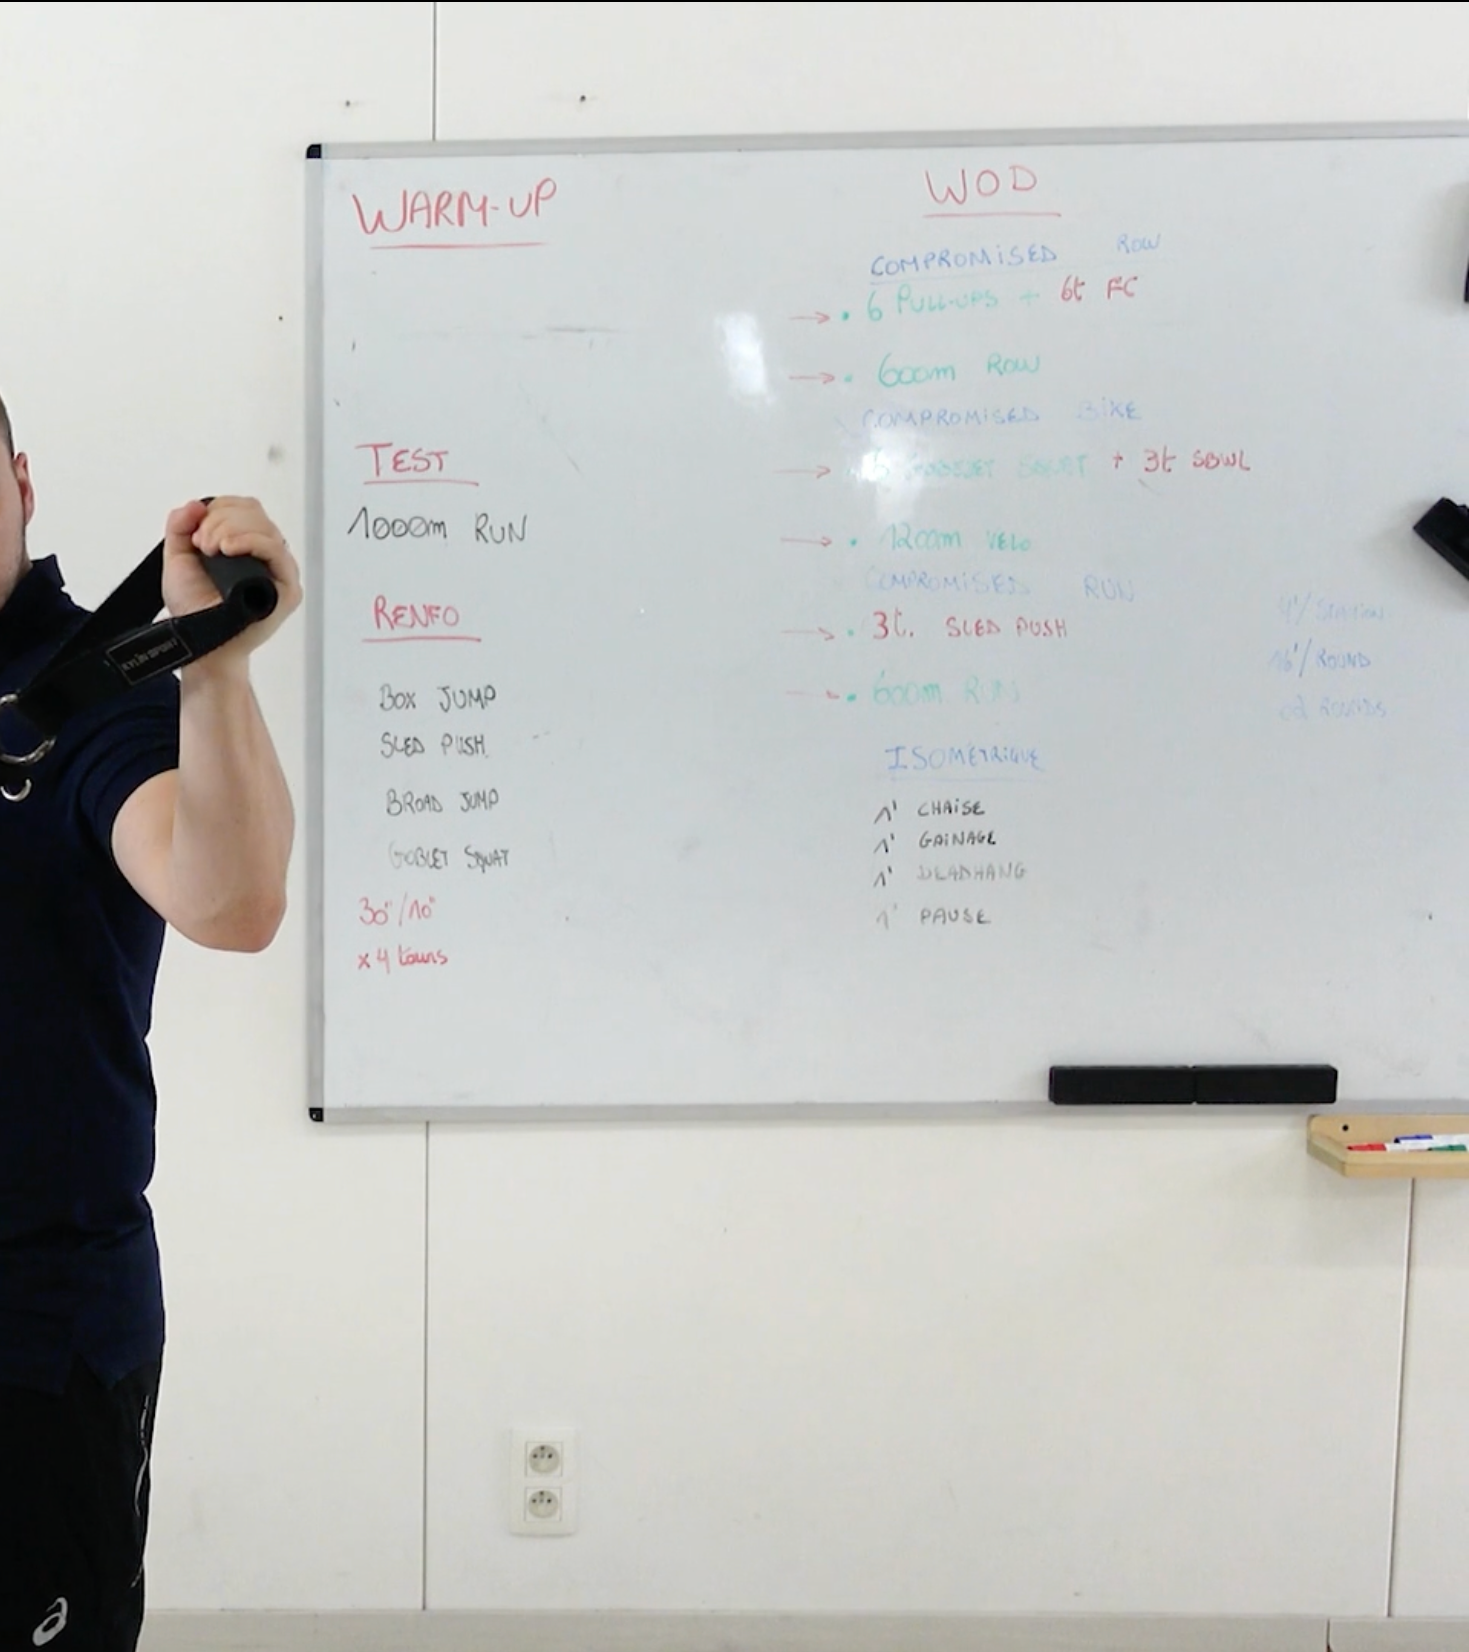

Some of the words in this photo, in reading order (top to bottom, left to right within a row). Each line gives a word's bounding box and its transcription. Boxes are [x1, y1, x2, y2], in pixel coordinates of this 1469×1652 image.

[926, 165, 1038, 205] WOD
[353, 178, 557, 235] WARM-UP
[1116, 233, 1162, 254] ROW
[867, 291, 883, 322] 6
[896, 284, 999, 315] PULL-UPS
[878, 352, 956, 388] 600m
[987, 353, 1041, 375] ROW
[354, 442, 449, 478] TEST
[347, 506, 448, 540] 1000m
[475, 513, 528, 544] RUN
[1083, 574, 1136, 602] RUN
[373, 594, 460, 630] RENFO
[944, 616, 1001, 640] SLED
[1016, 616, 1069, 640] PUSH
[380, 683, 417, 711] BOX
[439, 684, 497, 713] JUMP
[380, 731, 425, 758] SLED
[386, 788, 443, 816] BROAD
[460, 788, 499, 812] JUMP
[388, 841, 449, 870] GOBLET
[916, 862, 1028, 882] DEADHANG
[919, 907, 992, 926] PAUSE
